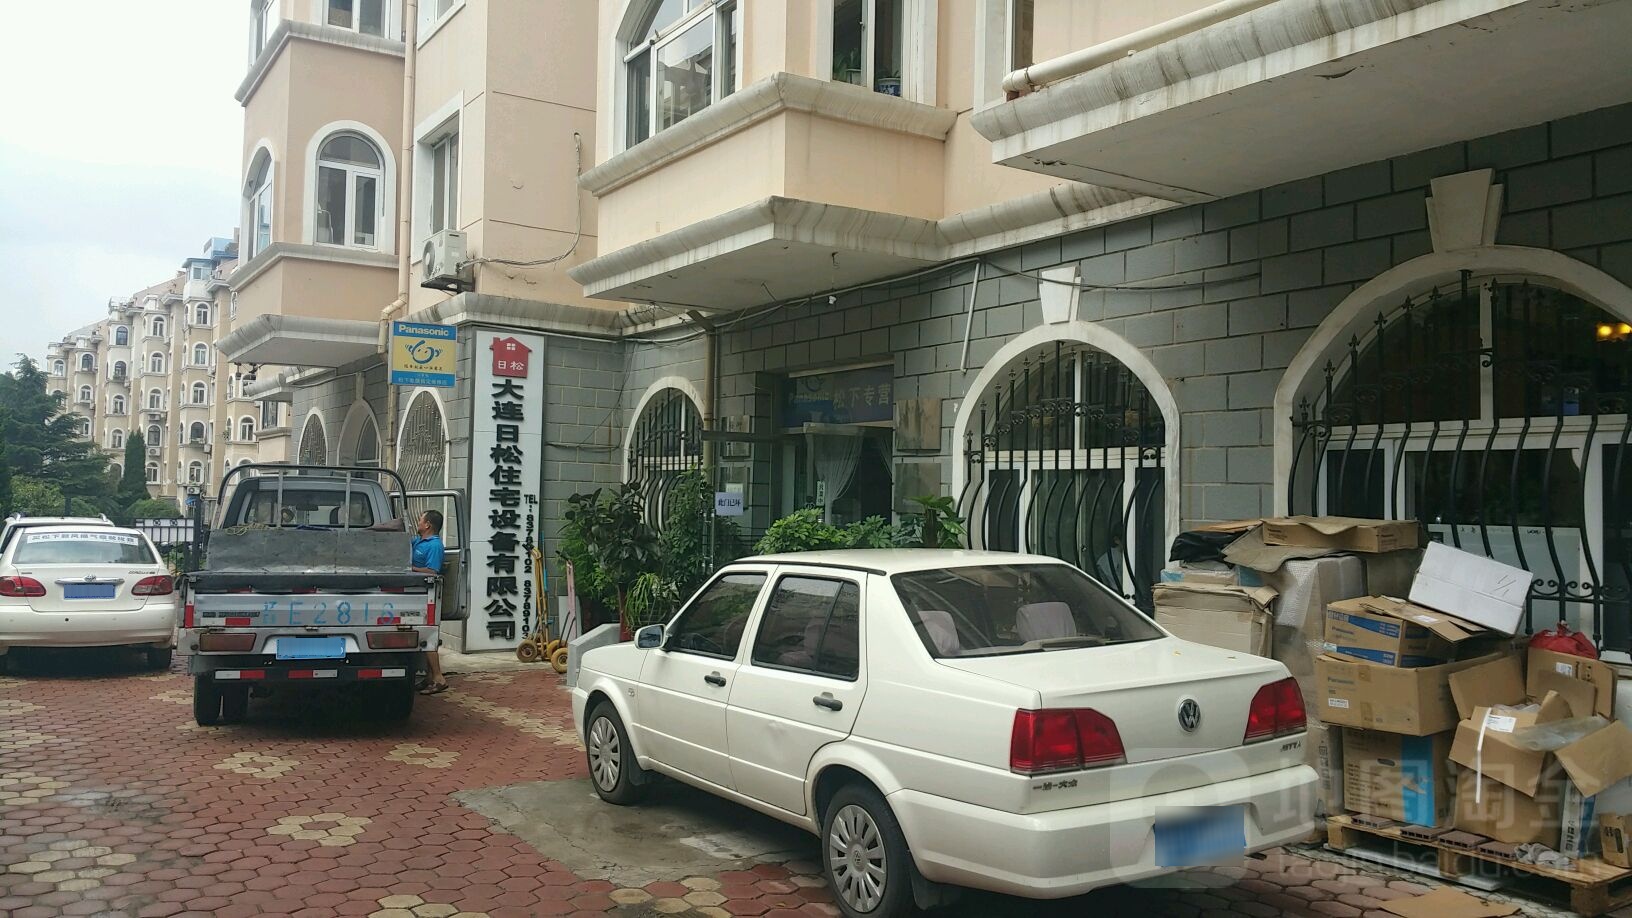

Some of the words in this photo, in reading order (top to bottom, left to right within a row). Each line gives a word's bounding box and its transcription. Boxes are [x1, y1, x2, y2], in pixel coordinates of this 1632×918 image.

[399, 324, 449, 336] Panasonic
[498, 360, 525, 370] 日松
[484, 379, 524, 641] 大连日松住宅设备有限公司
